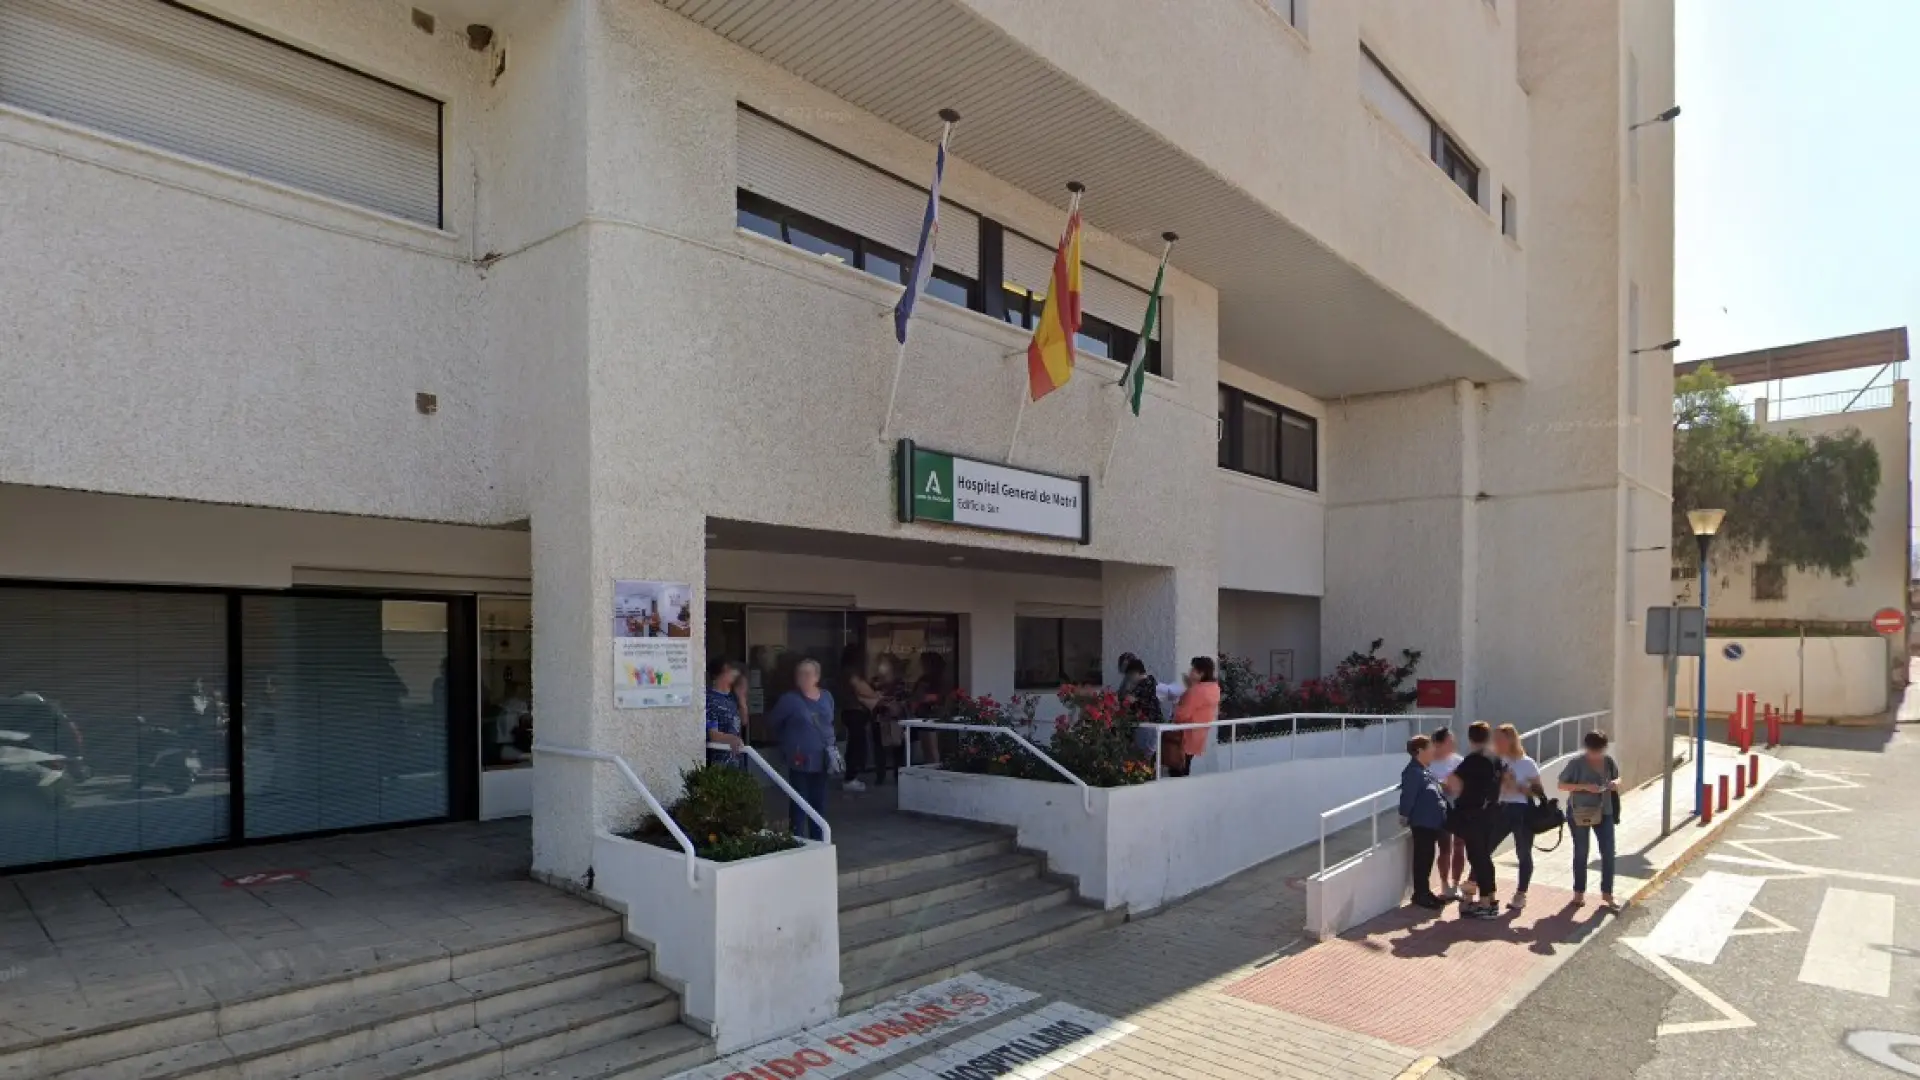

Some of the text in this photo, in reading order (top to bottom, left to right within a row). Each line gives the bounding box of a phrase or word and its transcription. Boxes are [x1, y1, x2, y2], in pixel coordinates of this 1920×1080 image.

[957, 475, 1077, 508] Hospital General de Motril
[825, 1002, 960, 1055] FUMAR
